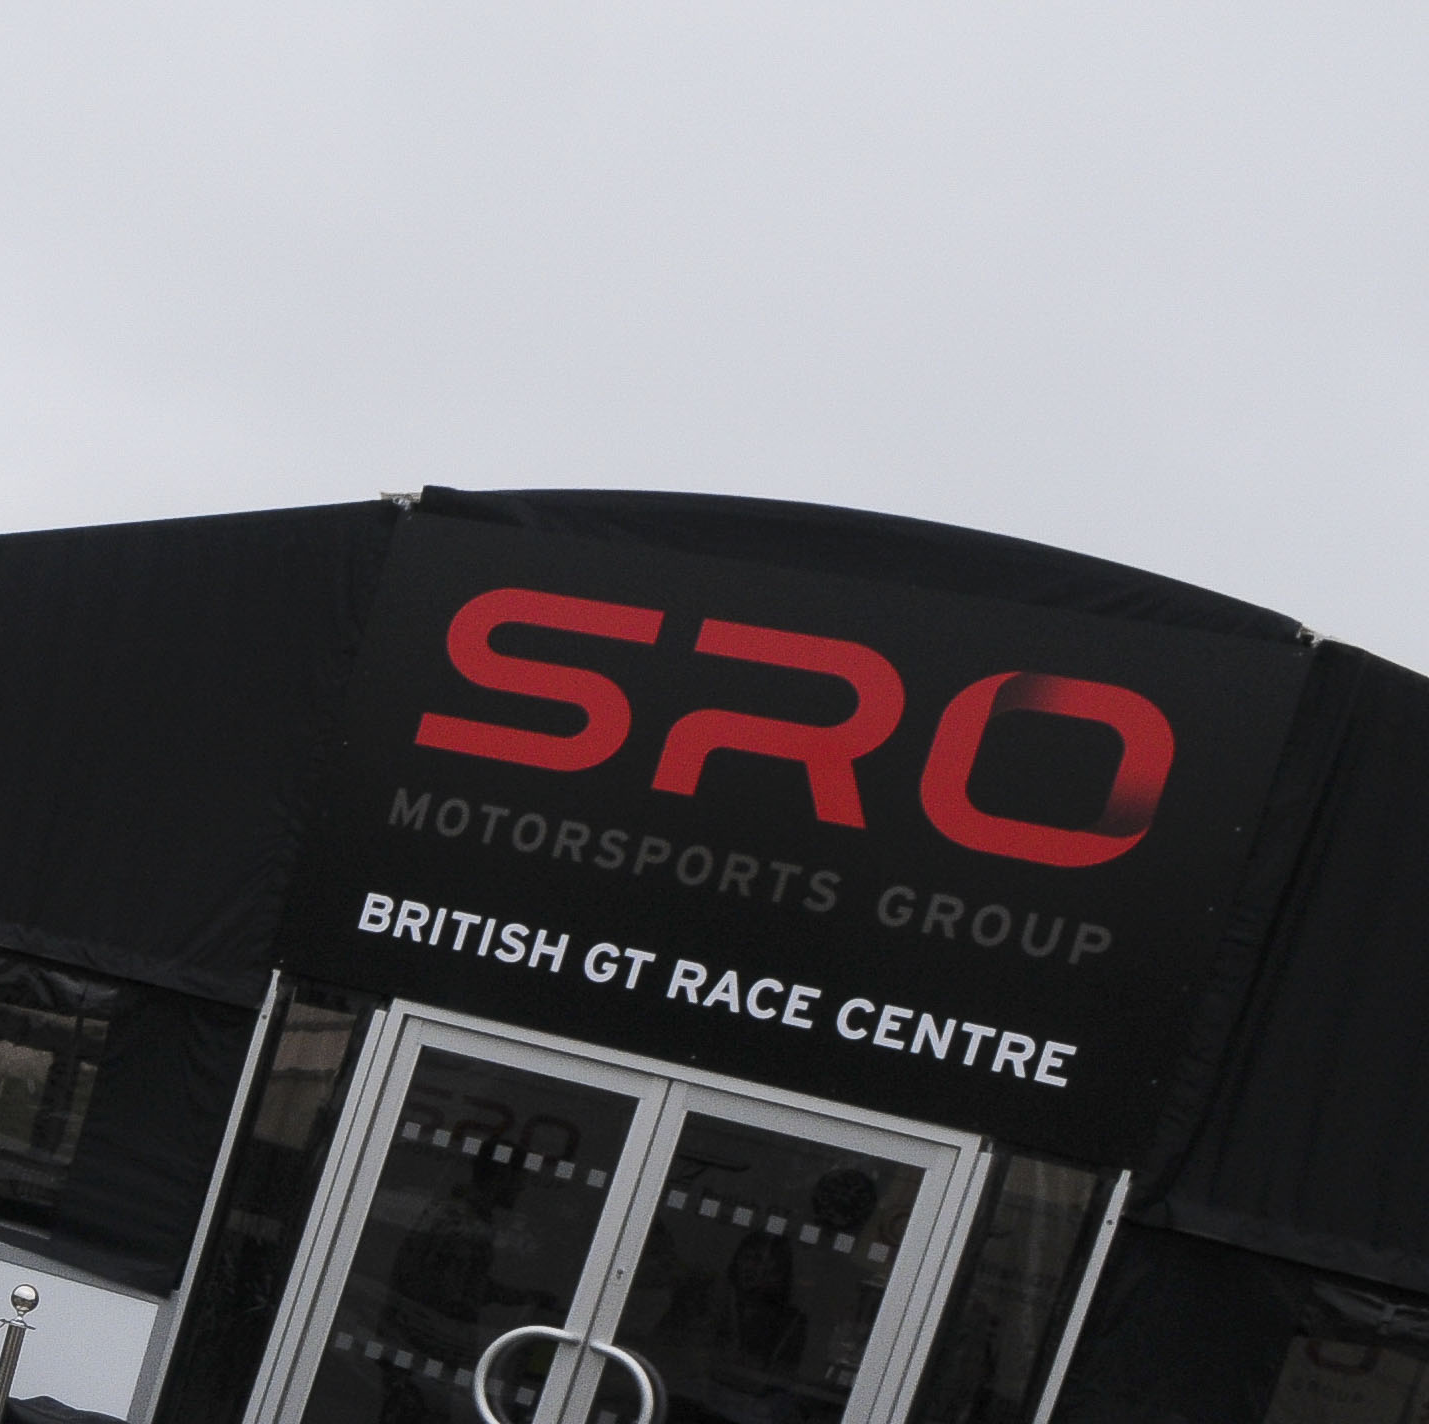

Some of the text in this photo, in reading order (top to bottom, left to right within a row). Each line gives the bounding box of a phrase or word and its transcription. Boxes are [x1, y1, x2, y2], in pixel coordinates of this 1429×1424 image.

[413, 586, 1176, 869] SRO
[388, 787, 1113, 967] MOTORSPORTS GROUP
[357, 892, 1077, 1088] BRITISH GT RACE CENTRE
